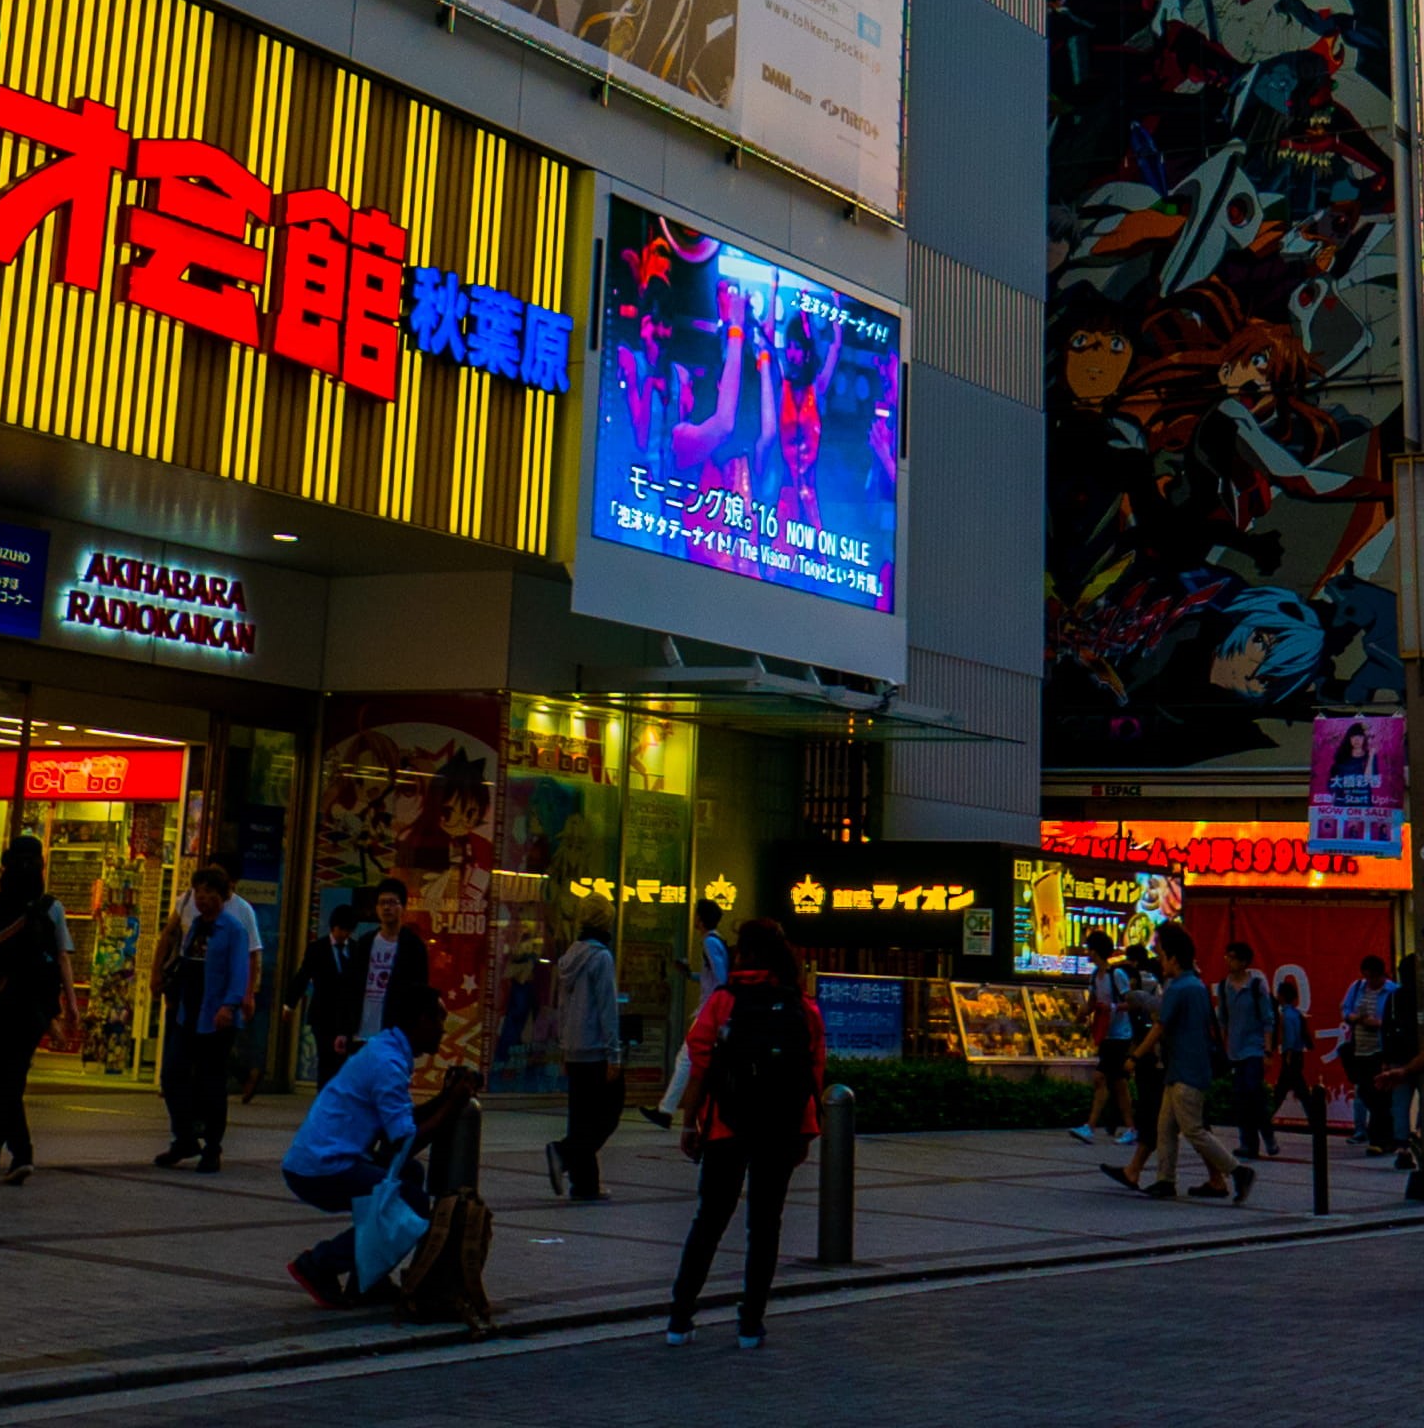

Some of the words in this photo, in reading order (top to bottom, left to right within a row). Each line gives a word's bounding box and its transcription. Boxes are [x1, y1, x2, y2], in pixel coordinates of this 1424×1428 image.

[411, 264, 577, 395] 秋葉原
[786, 519, 815, 552] NOW
[818, 528, 836, 556] ON
[839, 535, 870, 568] SALE
[81, 550, 248, 614] AKIHABARA
[67, 588, 257, 656] RADIOKAIKAN
[1105, 784, 1143, 797] ESPACE
[1317, 807, 1344, 817] NOW
[1345, 807, 1363, 817] ON
